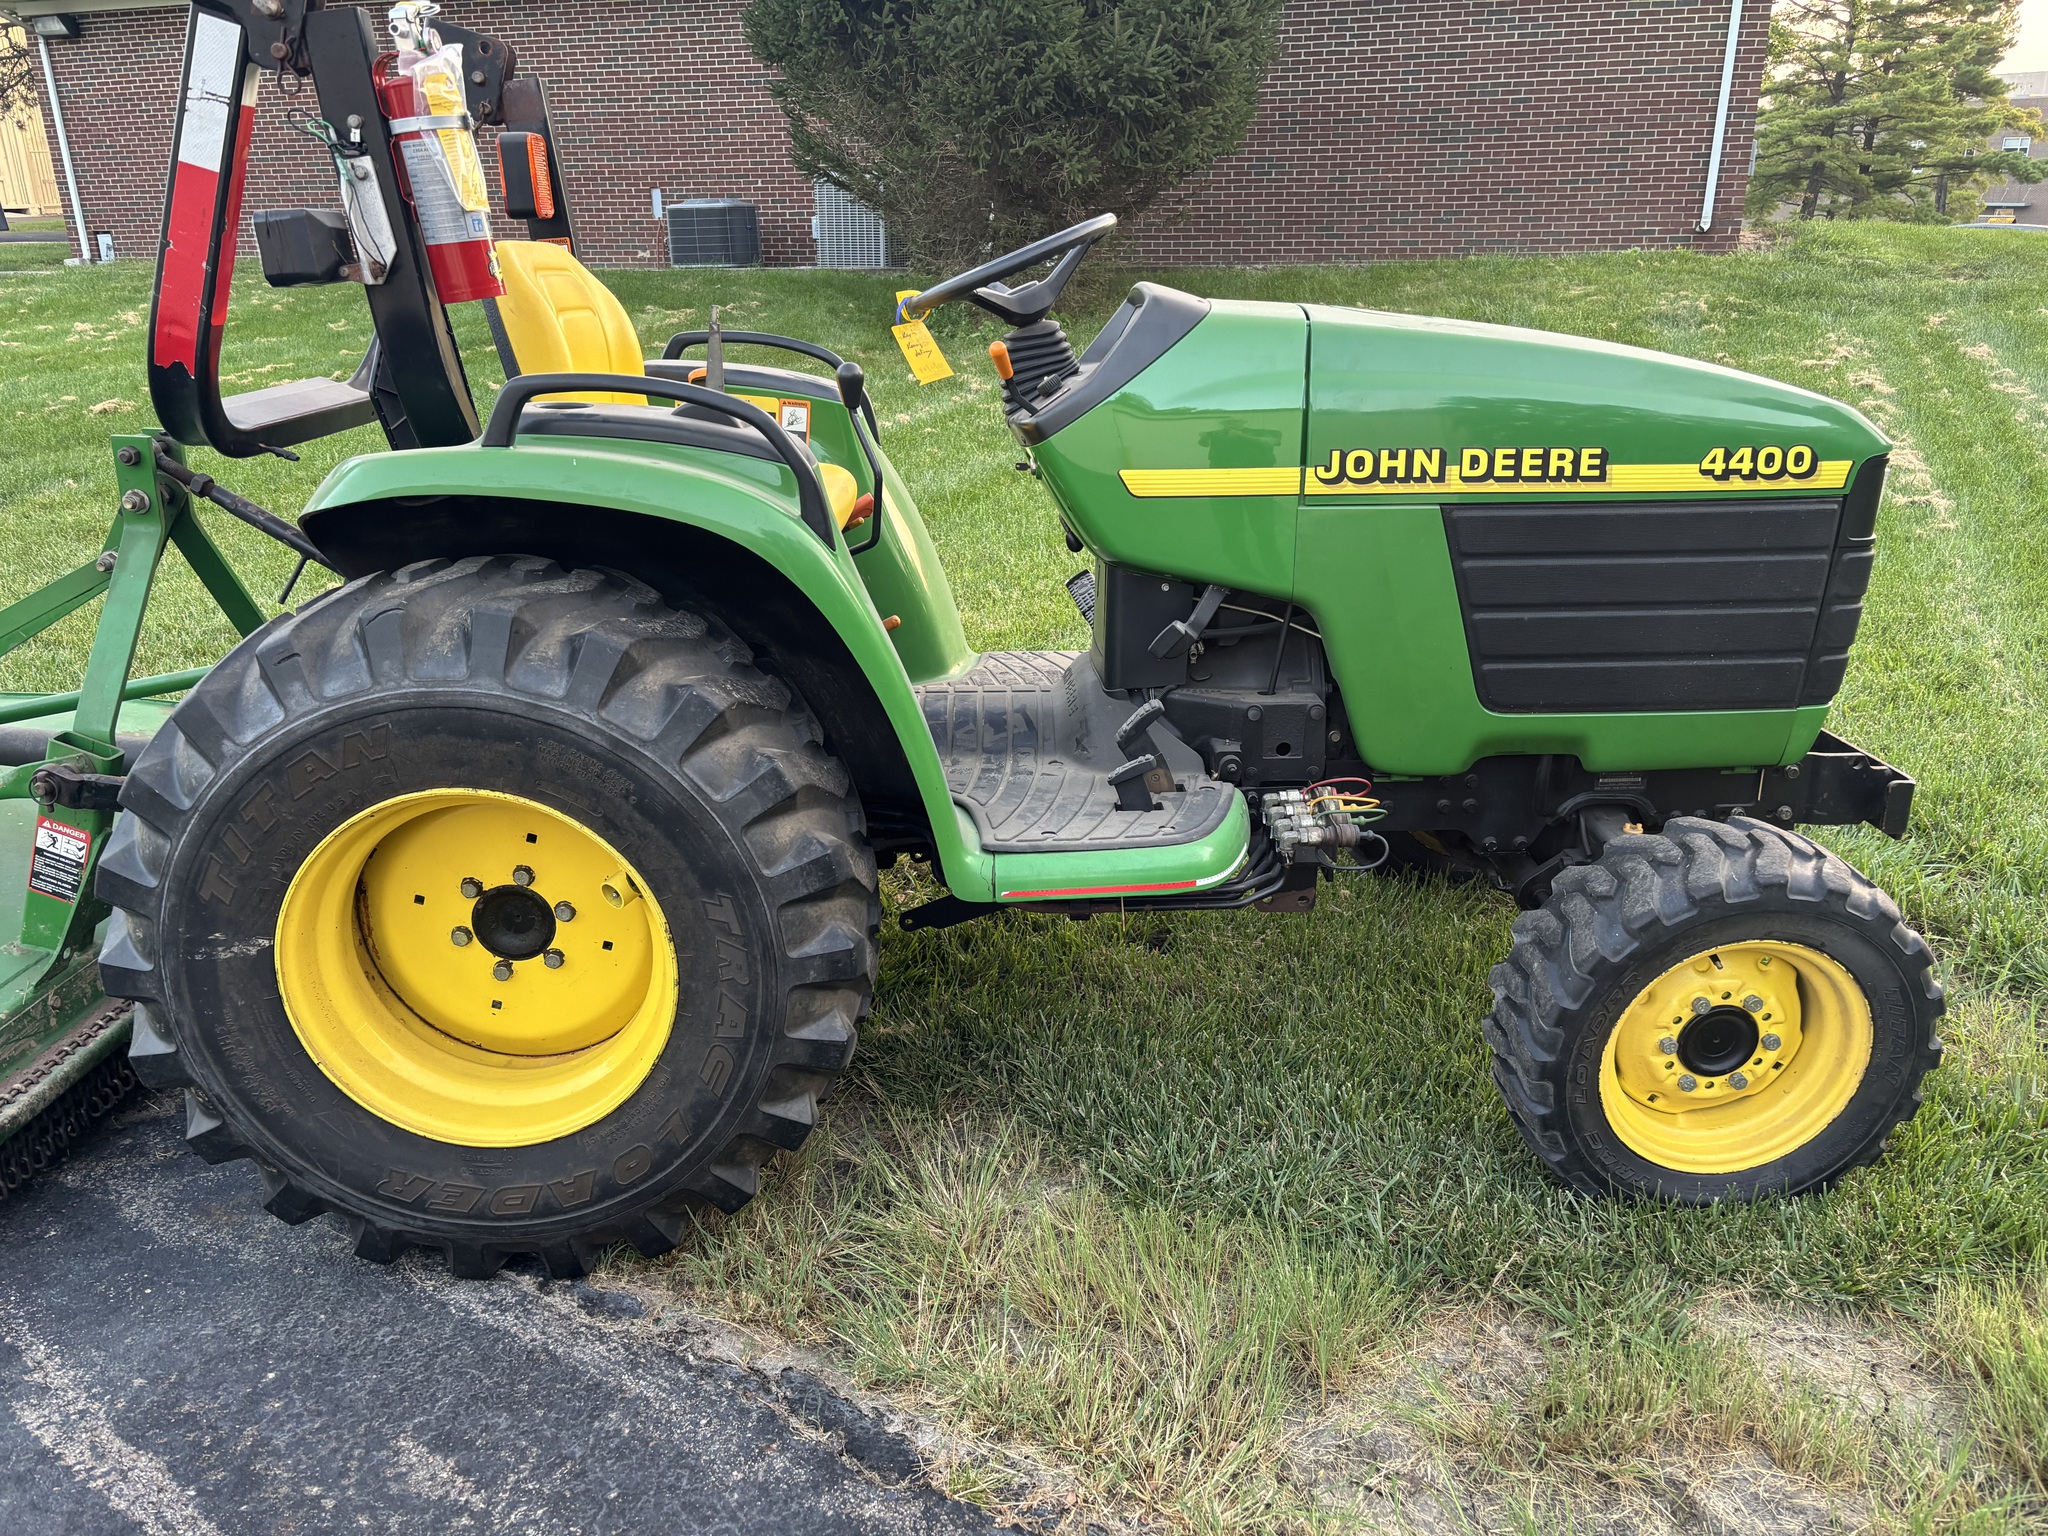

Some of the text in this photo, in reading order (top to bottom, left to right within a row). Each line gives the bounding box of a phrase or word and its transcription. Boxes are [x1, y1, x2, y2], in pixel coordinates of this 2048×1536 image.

[1315, 447, 1609, 485] JOHN DEERE
[1699, 444, 1818, 481] 4400
[569, 748, 605, 771] RATING
[52, 822, 86, 840] DANGER
[200, 722, 393, 906] TITAN
[291, 828, 306, 842] IN
[304, 810, 326, 829] THE
[698, 893, 750, 1098] TRAC
[1575, 972, 1641, 1105] LOADER
[1883, 988, 1907, 1087] TITAN
[655, 1074, 670, 1092] FOR
[620, 1091, 657, 1126] CUSTOMER
[377, 1107, 692, 1214] LOADER
[1585, 1130, 1650, 1188] TRAC
